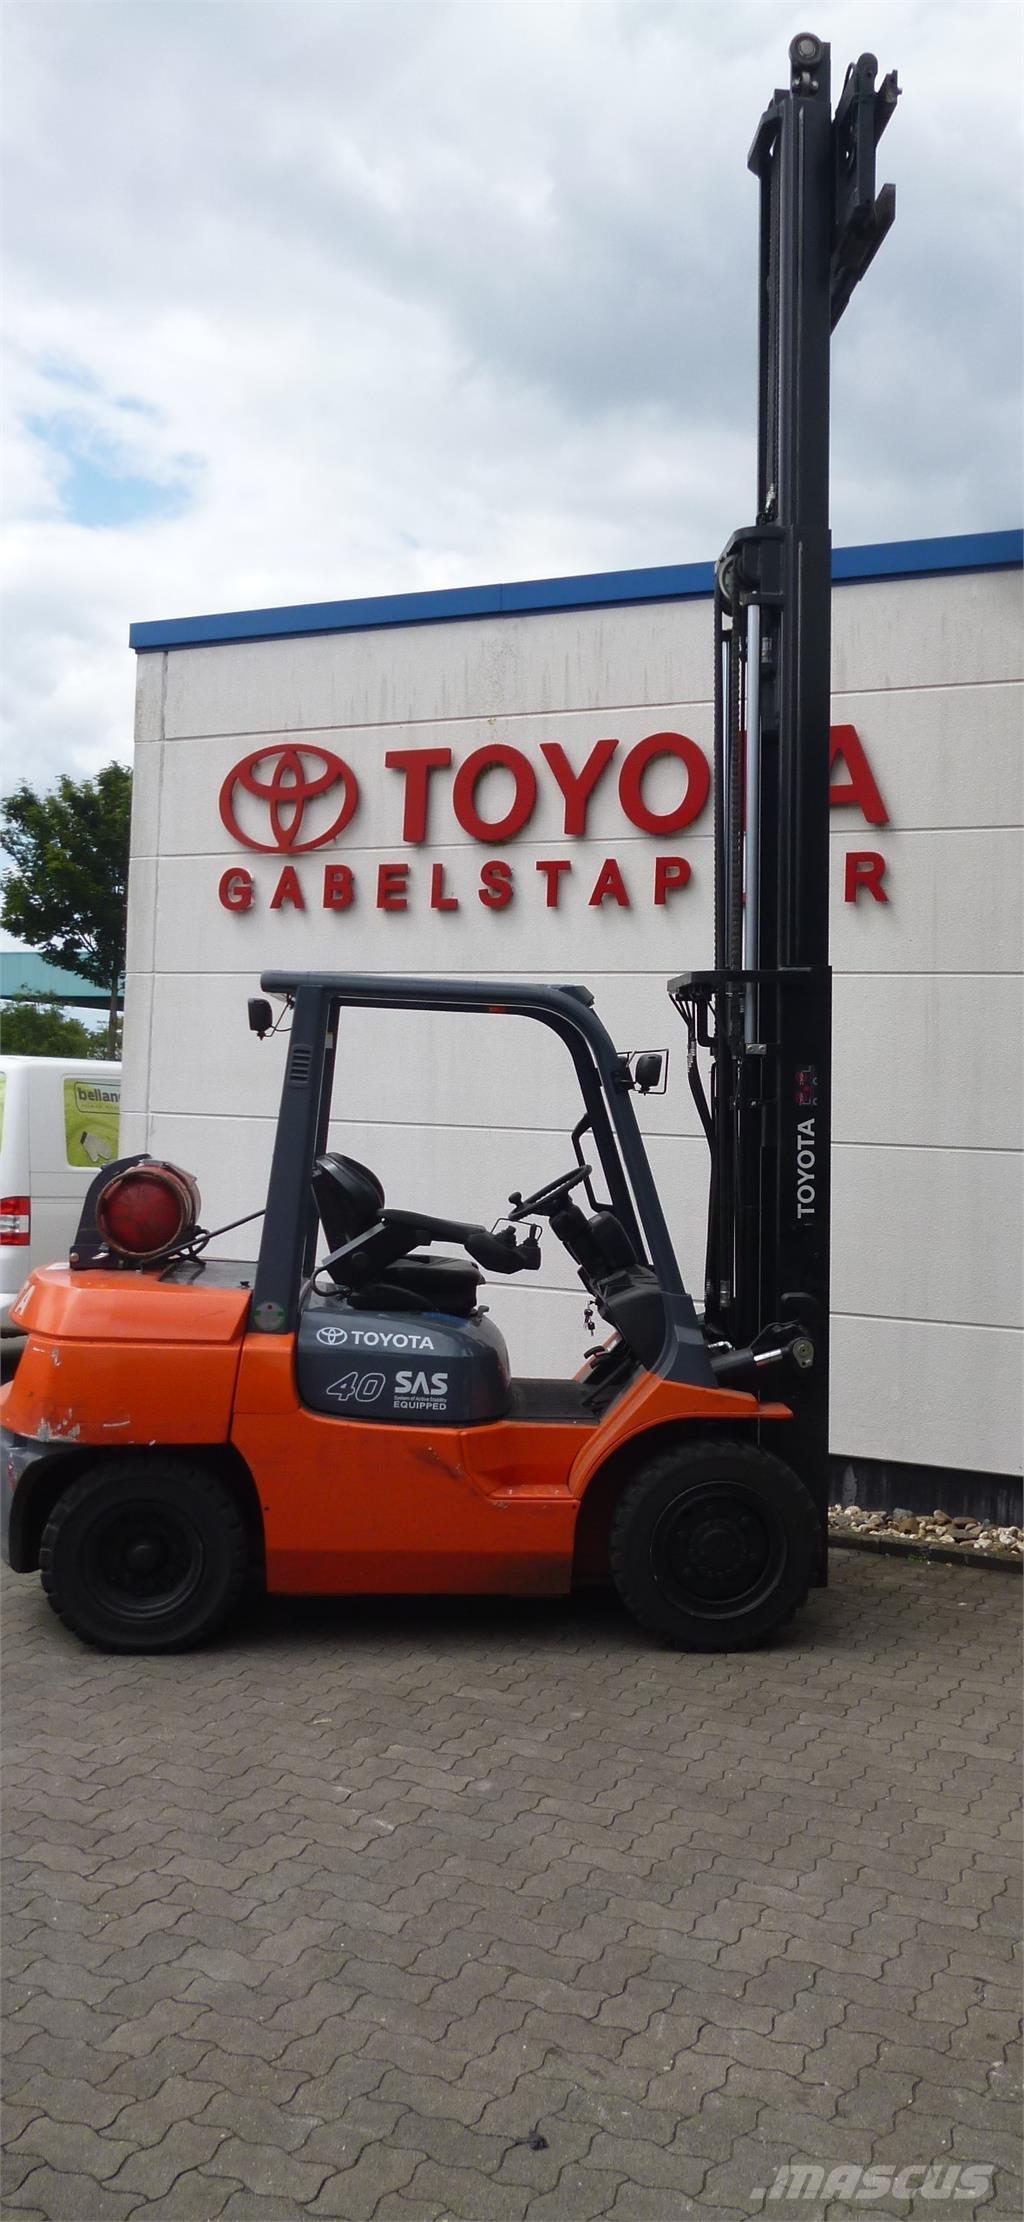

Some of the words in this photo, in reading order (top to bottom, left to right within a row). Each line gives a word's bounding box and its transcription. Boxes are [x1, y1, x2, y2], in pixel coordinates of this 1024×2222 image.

[385, 724, 889, 845] TOYOA
[218, 851, 889, 911] GABELSTAPR
[77, 1087, 120, 1102] bellan
[797, 1118, 815, 1219] TOYOTA
[351, 1331, 434, 1350] TOYOTA
[326, 1371, 386, 1403] 40
[394, 1371, 448, 1395] SAS
[393, 1400, 447, 1410] EQUIPPED
